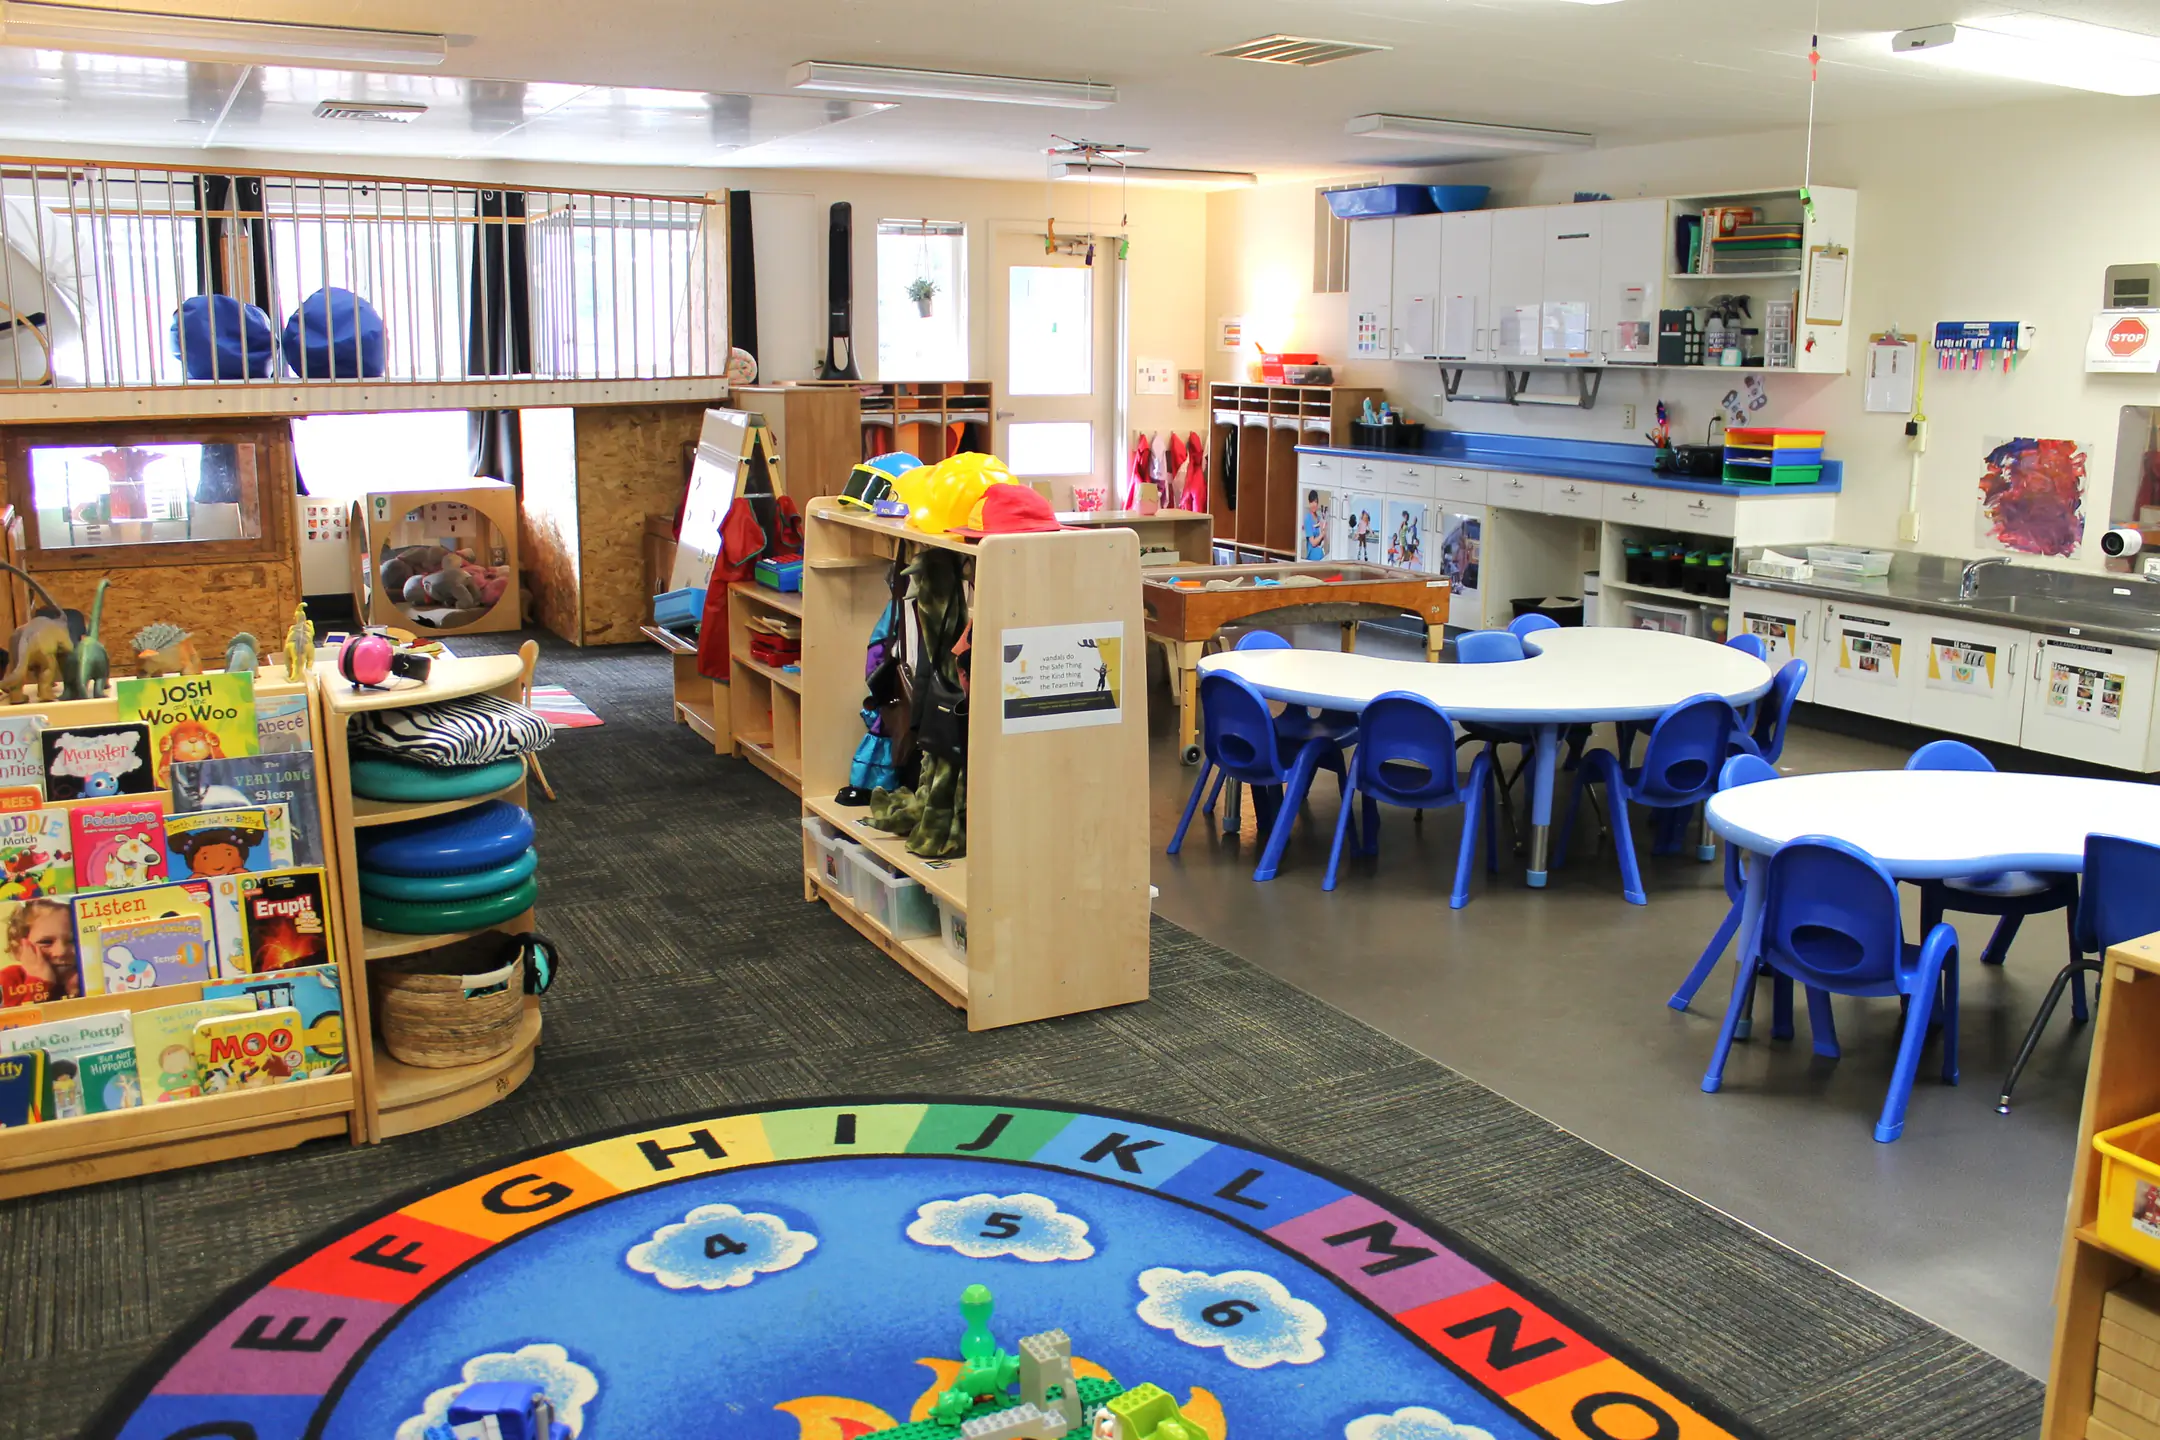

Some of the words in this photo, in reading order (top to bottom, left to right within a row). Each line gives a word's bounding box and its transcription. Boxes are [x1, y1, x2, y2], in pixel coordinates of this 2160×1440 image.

[2112, 333, 2144, 343] STOP
[1042, 653, 1065, 661] vandals
[1051, 662, 1064, 670] Safe
[1065, 661, 1082, 671] Thing
[2057, 664, 2070, 672] Safe
[2084, 669, 2097, 677] Kind
[1051, 672, 1065, 680] Kind
[1066, 671, 1082, 681] thing
[158, 680, 213, 706] JOSH
[1069, 681, 1084, 690] thing
[173, 702, 188, 711] and
[193, 698, 207, 706] the
[138, 709, 188, 726] Woo
[189, 705, 238, 722] Woo
[62, 744, 129, 766] Monster
[263, 761, 280, 769] The
[234, 773, 272, 787] VERY
[276, 770, 311, 784] LONG
[255, 790, 294, 801] Sleep
[83, 811, 156, 828] Peekaboo
[3, 835, 38, 846] Match
[80, 898, 147, 919] Listen
[255, 896, 311, 917] Erupt!
[153, 953, 182, 964] Tengo
[9, 982, 44, 996] LOTS
[34, 991, 50, 1002] OF
[12, 1035, 47, 1052] Let's
[49, 1033, 70, 1045] Go
[80, 1023, 124, 1041] Potty!
[209, 1028, 293, 1063] MOO
[979, 1212, 1023, 1240] 5
[230, 1314, 348, 1353] E
[349, 1233, 428, 1275] F
[481, 1173, 574, 1215] G
[635, 1128, 729, 1171] H
[833, 1113, 857, 1145] I
[956, 1113, 1014, 1152] J
[1080, 1132, 1165, 1174] K
[1213, 1168, 1269, 1210] L
[1322, 1220, 1439, 1276] M
[1443, 1306, 1568, 1372] N
[703, 1232, 748, 1260] 4
[1200, 1298, 1261, 1329] 6
